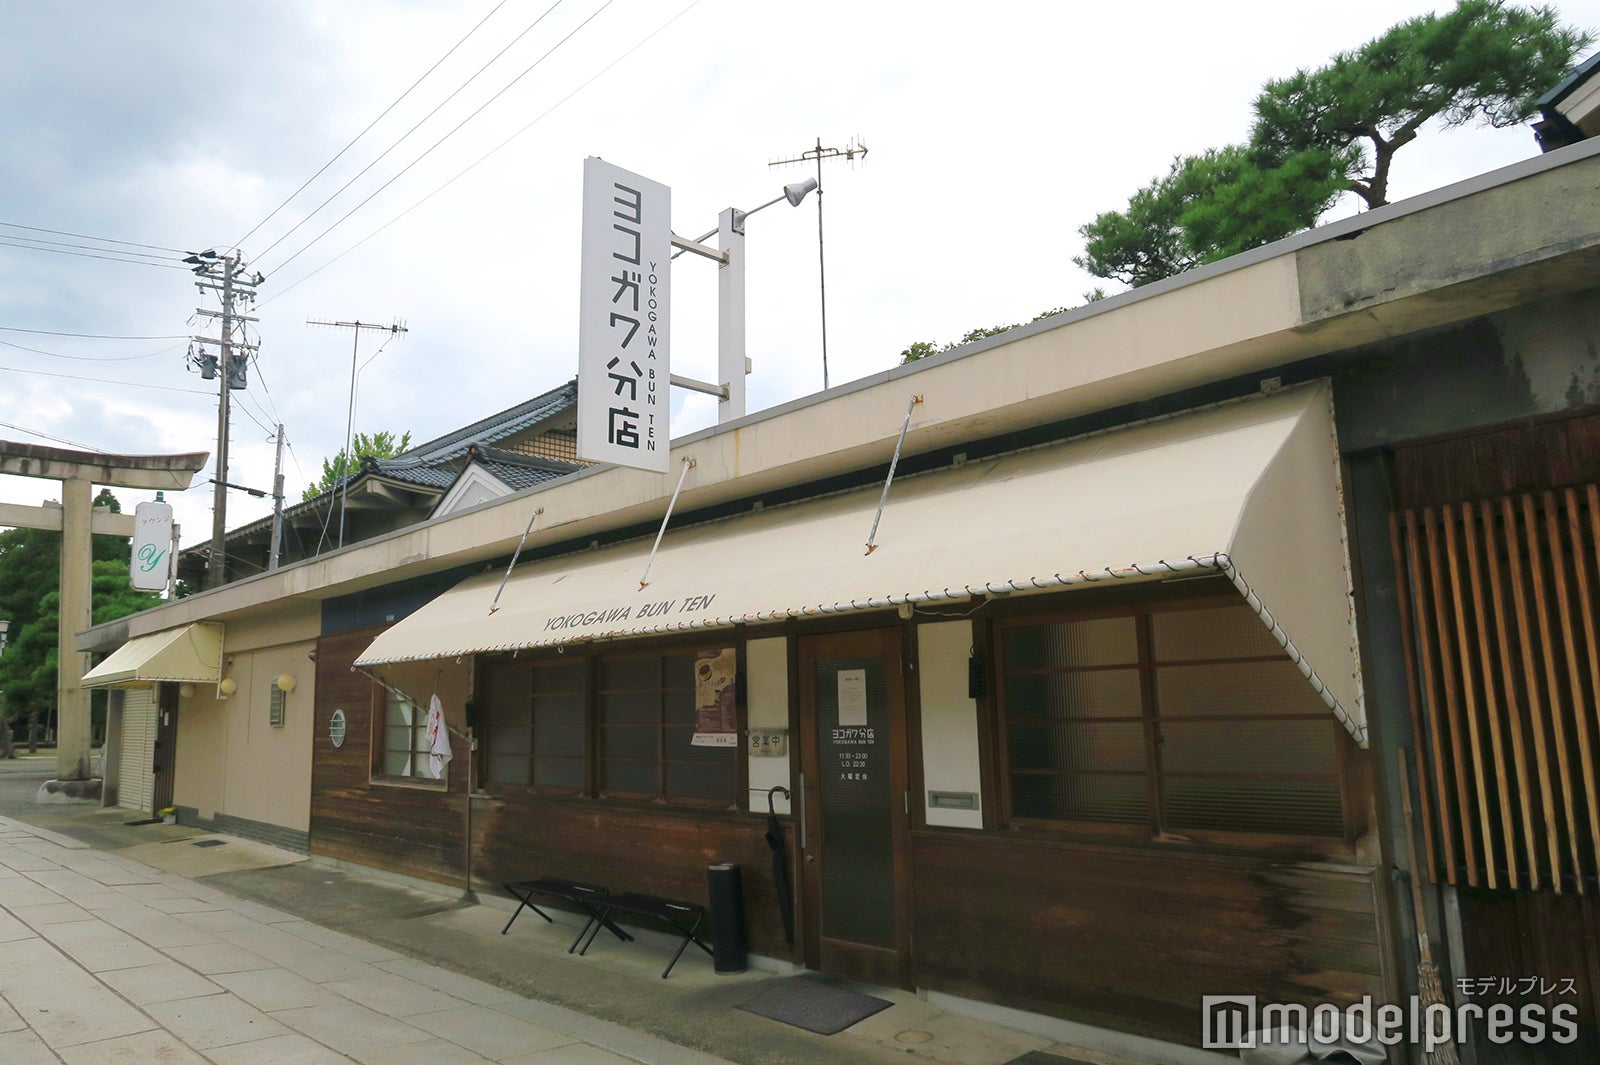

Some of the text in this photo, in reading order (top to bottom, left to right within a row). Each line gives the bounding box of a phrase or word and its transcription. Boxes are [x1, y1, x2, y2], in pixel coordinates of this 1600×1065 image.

[606, 182, 643, 449] ヨコガワ分店
[647, 261, 657, 451] YOKOGAWA BUN TEN
[543, 594, 716, 632] YOKOGAWA BUN TEN
[832, 728, 875, 739] ヨコガワ分店
